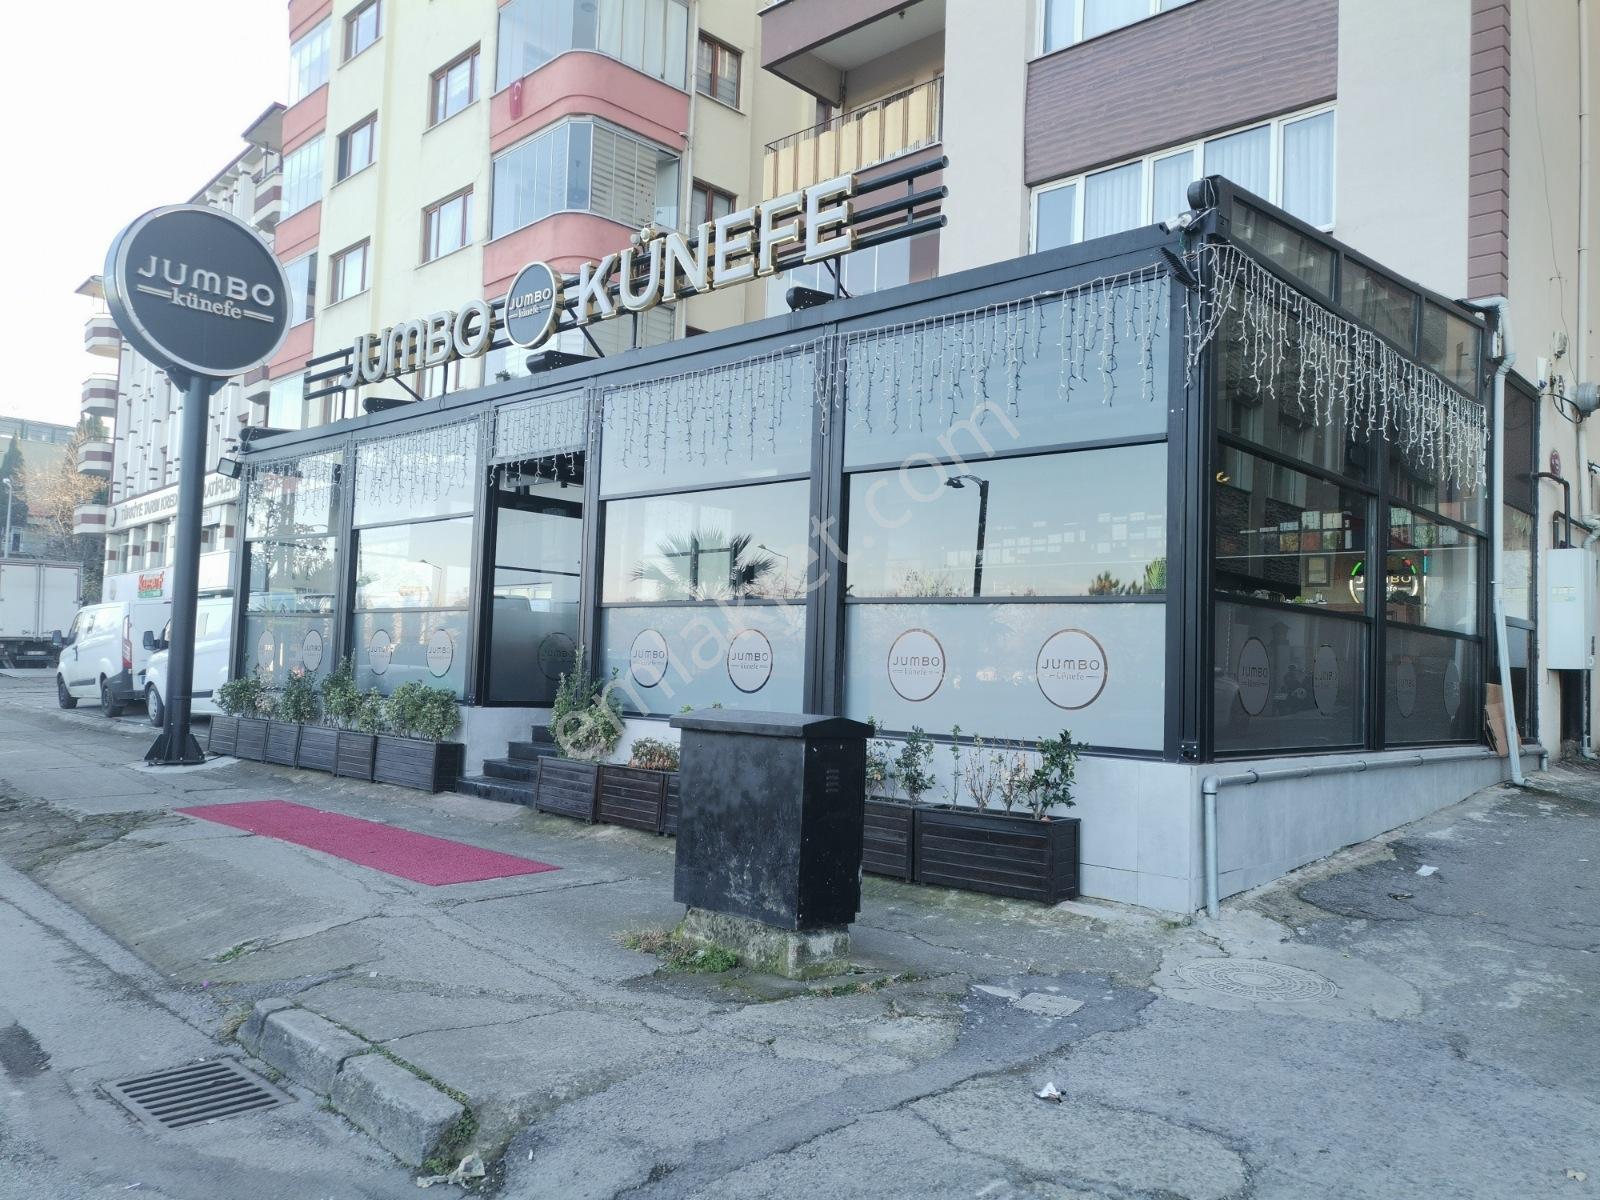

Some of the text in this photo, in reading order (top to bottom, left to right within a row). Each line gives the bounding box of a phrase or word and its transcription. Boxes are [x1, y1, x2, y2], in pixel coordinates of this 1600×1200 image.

[137, 255, 275, 306] JUMBO
[341, 174, 855, 389] JUMBO KÜNEFE
[171, 287, 242, 319] künefe
[508, 287, 551, 310] JUMBO
[633, 649, 666, 659] JUMBO
[731, 652, 769, 662] JUMBO
[892, 655, 940, 667] JUMBO
[1041, 658, 1100, 671] JUMBO
